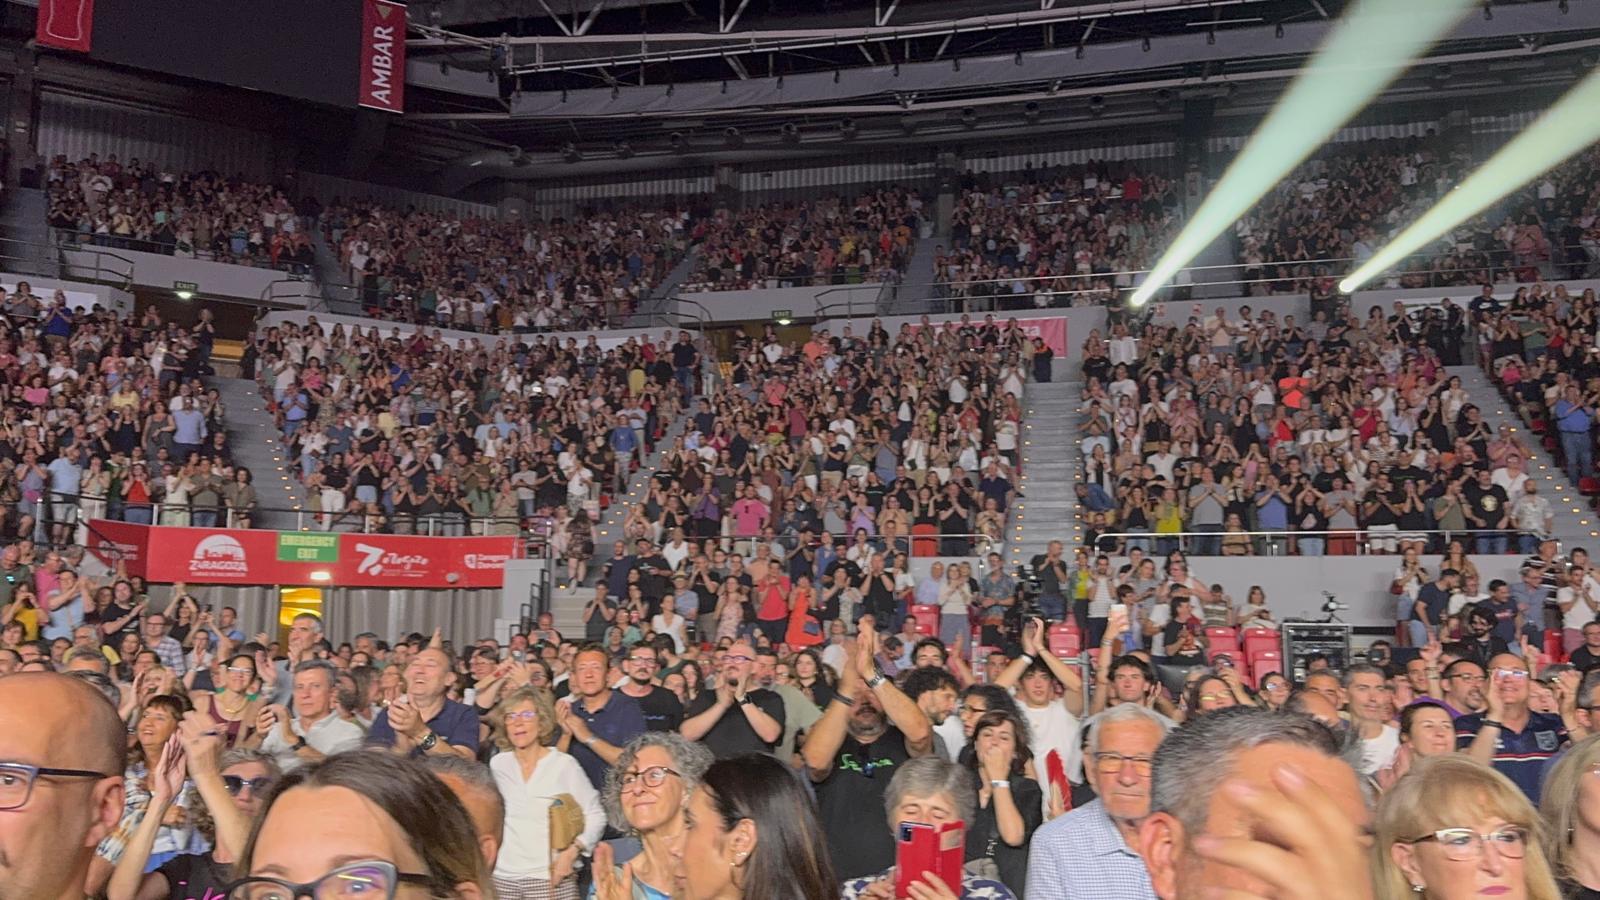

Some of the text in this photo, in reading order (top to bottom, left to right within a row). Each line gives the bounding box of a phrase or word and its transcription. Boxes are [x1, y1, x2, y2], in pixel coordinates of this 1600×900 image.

[371, 26, 394, 105] AMBAR
[280, 535, 336, 546] EMERGENCY
[297, 548, 319, 559] EXIT
[189, 560, 248, 572] ZARAGOZA
